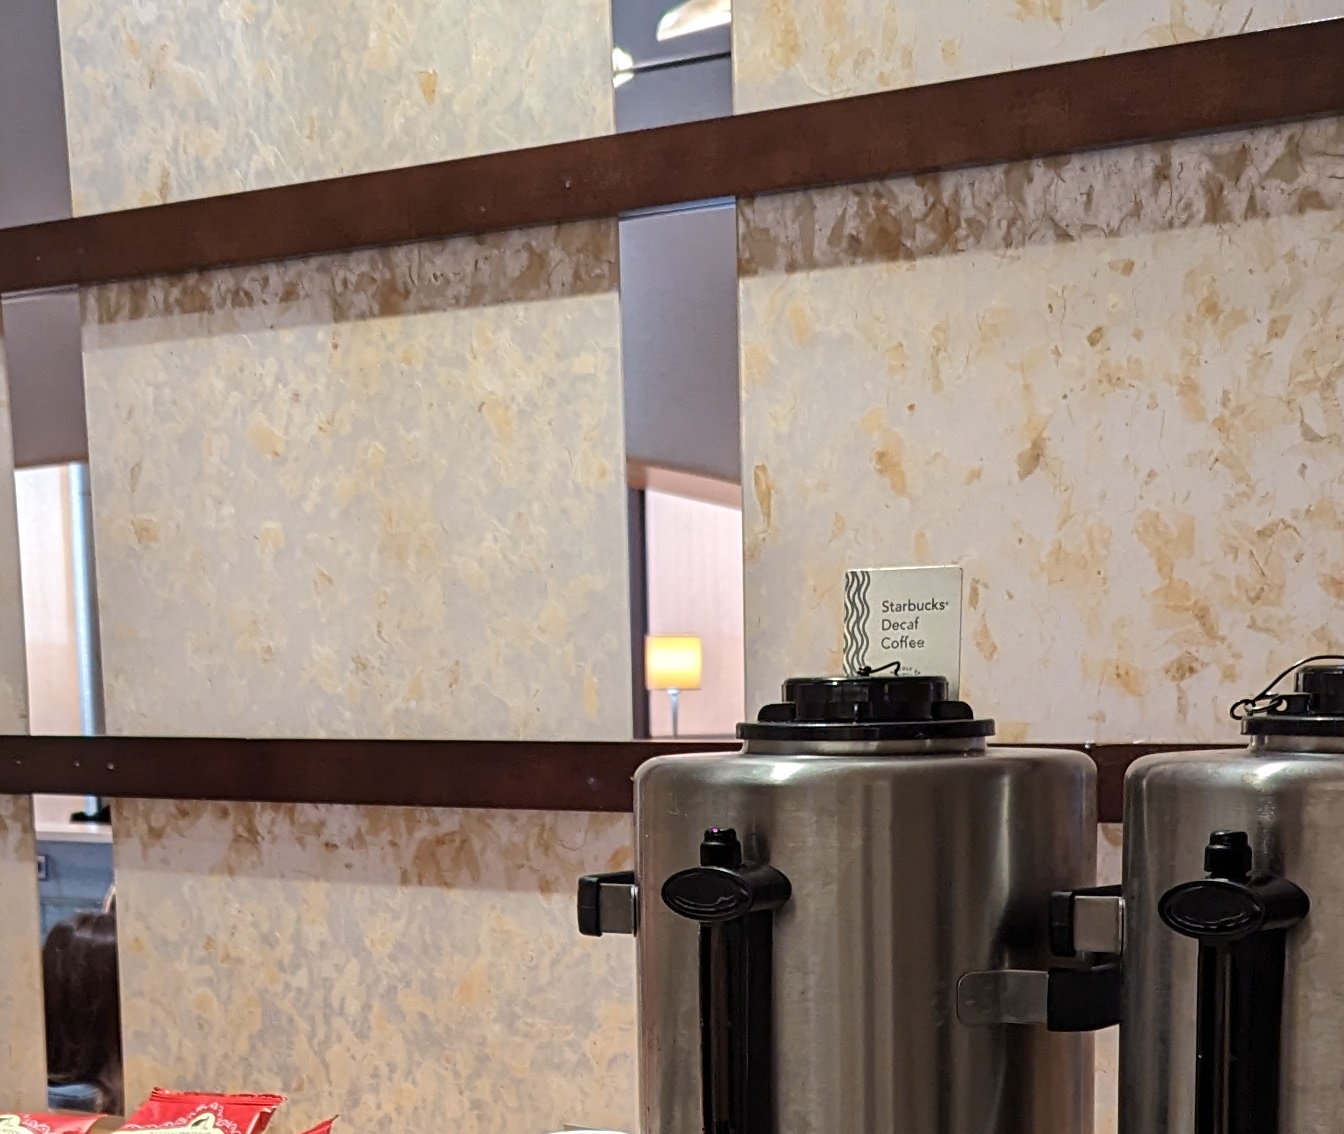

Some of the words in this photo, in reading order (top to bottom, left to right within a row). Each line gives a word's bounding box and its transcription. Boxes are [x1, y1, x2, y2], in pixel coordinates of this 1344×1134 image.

[881, 598, 946, 613] Starbucks
[881, 617, 920, 631] Decaf
[881, 636, 925, 650] Coffee
